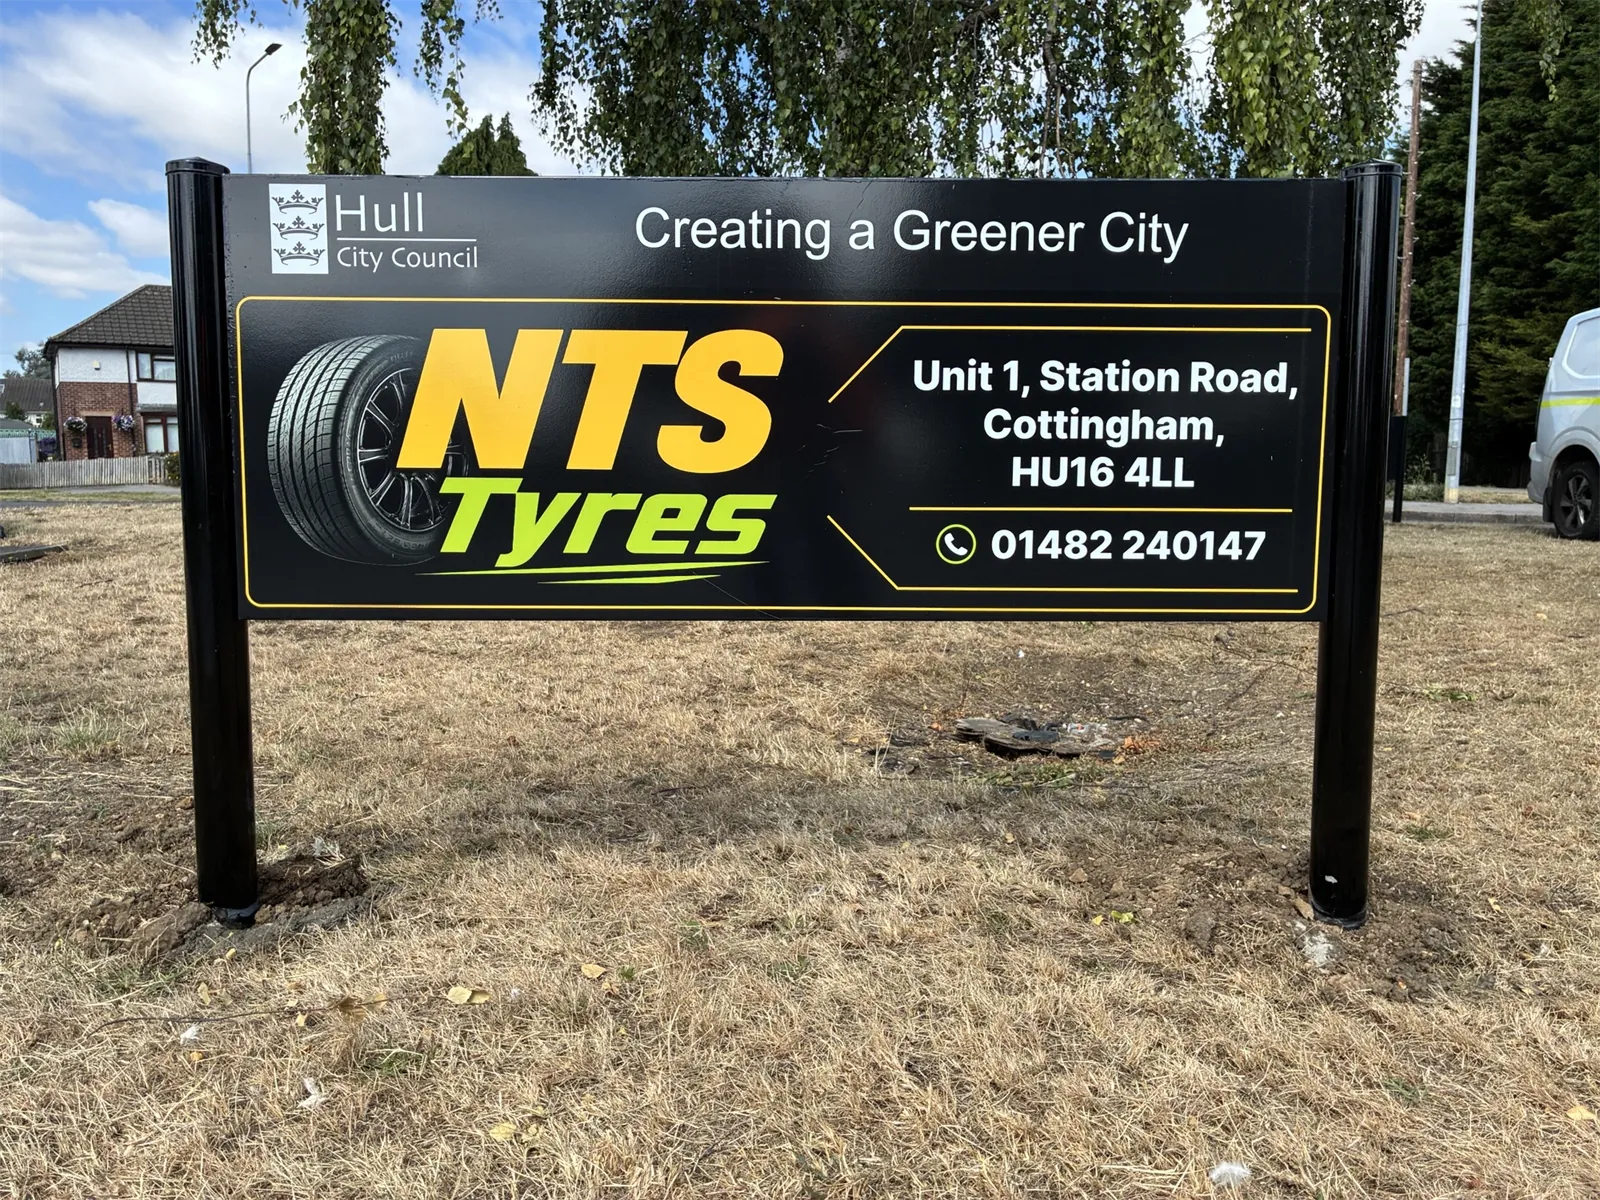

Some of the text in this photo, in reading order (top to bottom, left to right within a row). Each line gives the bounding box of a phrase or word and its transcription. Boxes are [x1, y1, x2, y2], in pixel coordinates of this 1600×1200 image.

[335, 191, 423, 232] Hull
[635, 207, 1189, 263] Creating a Greener City
[337, 246, 478, 273] City Council
[914, 359, 1298, 400] Unit 1, Station Road,
[397, 328, 784, 473] NTS
[984, 407, 1225, 448] Cottingham,
[1012, 457, 1195, 488] HU16 4LL
[439, 477, 777, 568] Tyres
[992, 530, 1266, 561] 01482 240147
